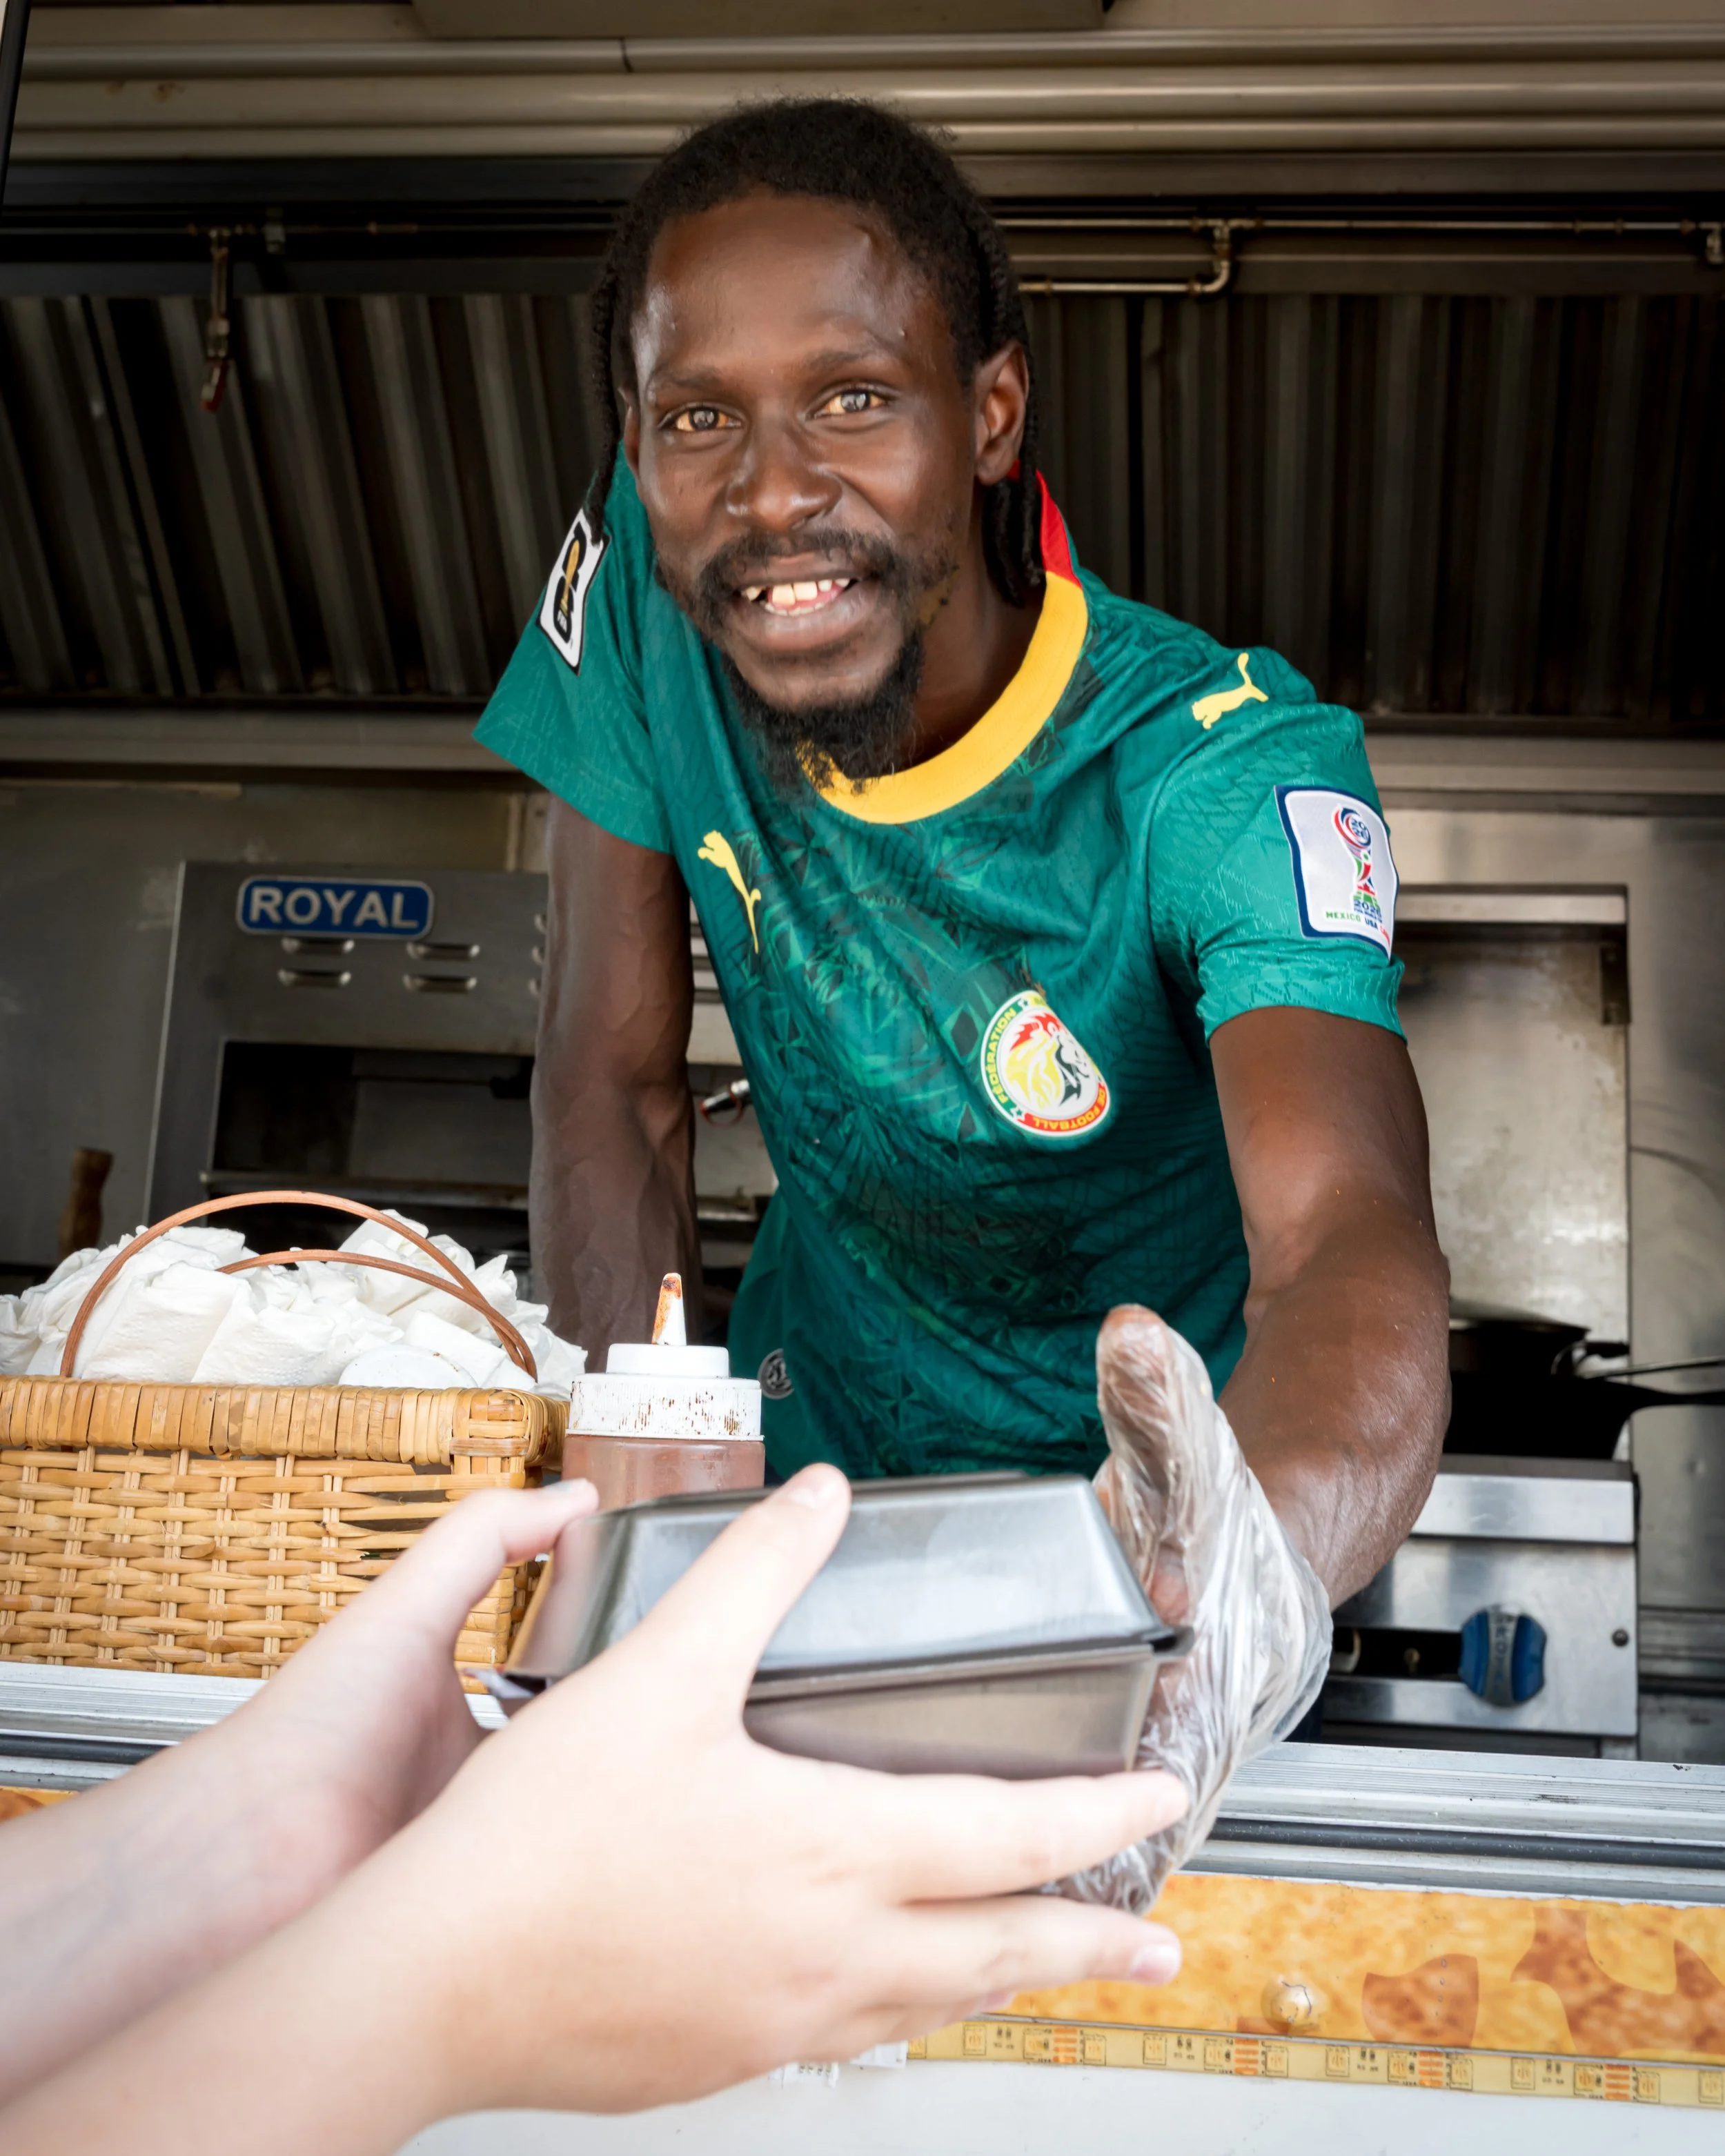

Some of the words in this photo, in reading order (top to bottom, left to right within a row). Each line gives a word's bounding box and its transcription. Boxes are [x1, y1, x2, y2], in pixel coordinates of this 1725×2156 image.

[249, 885, 418, 928] ROYAL
[1354, 900, 1381, 918] 2026
[1326, 911, 1361, 922] MEXICO
[1365, 918, 1378, 929] USA
[1033, 1105, 1101, 1130] FOOTBALL
